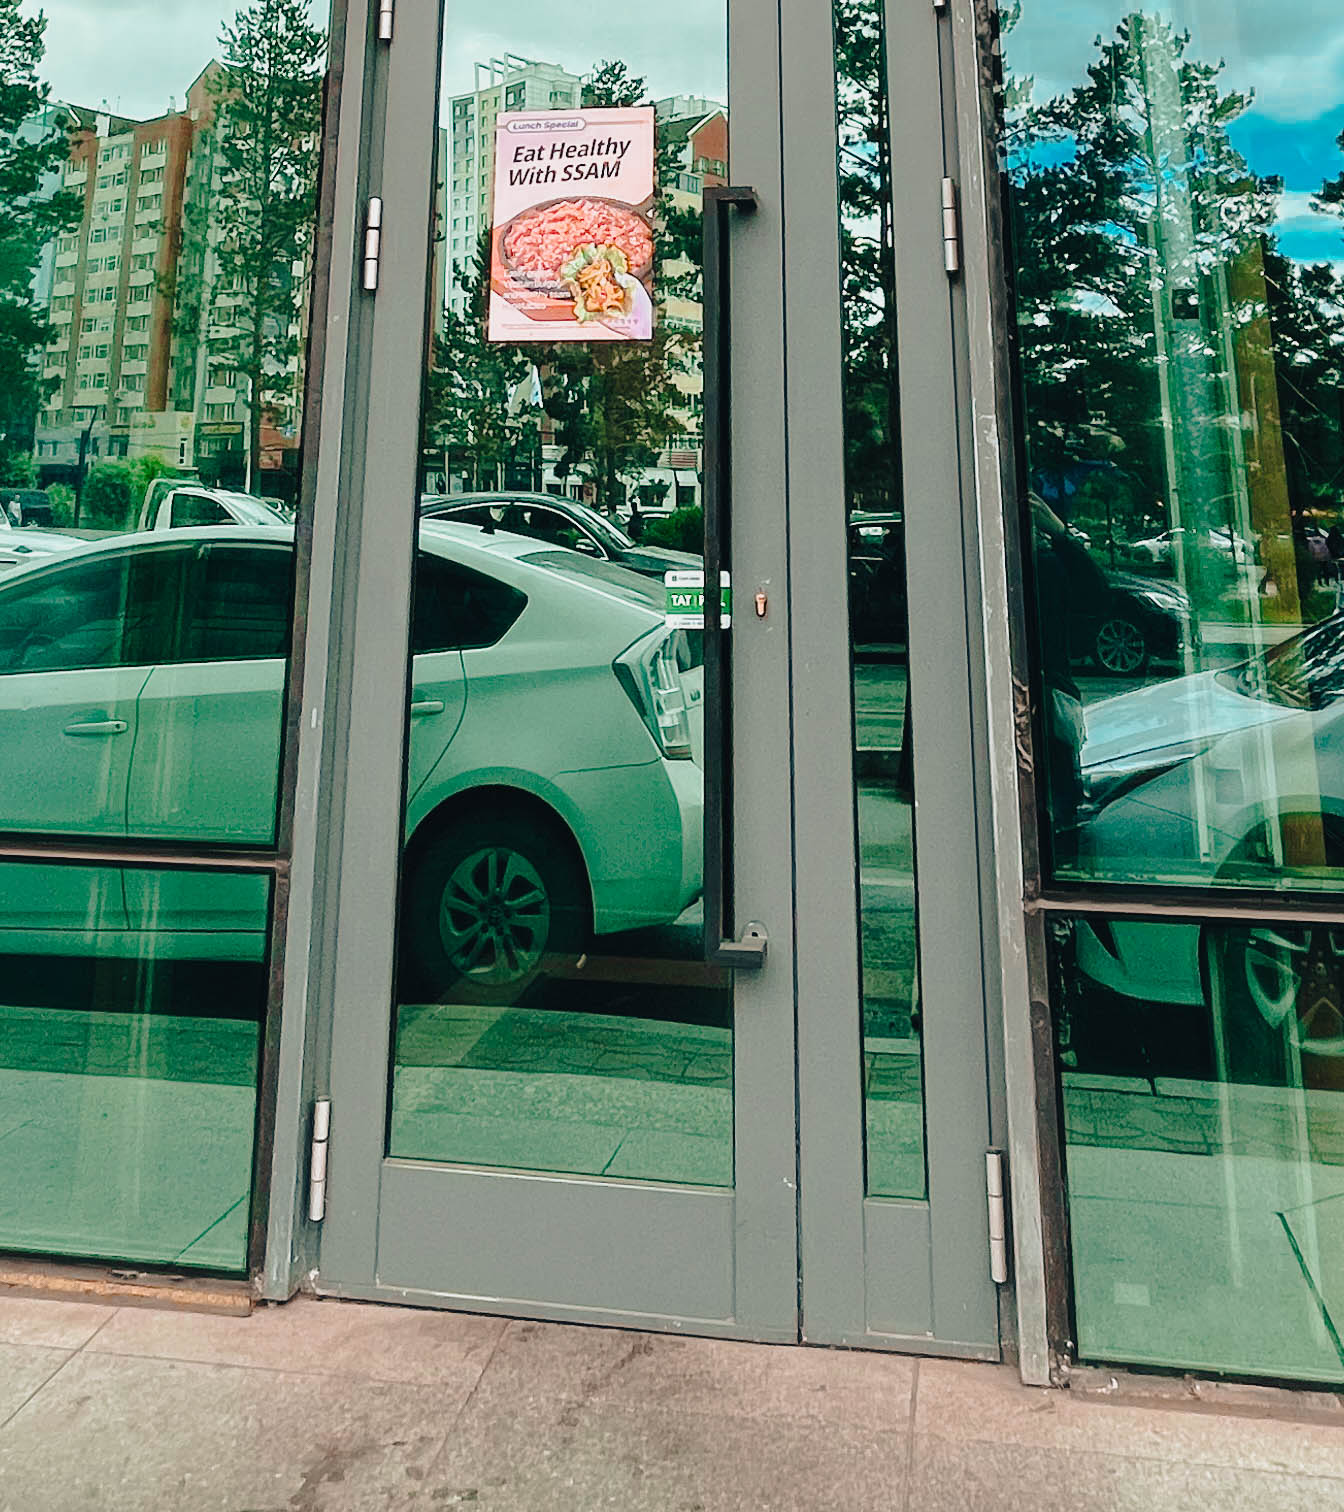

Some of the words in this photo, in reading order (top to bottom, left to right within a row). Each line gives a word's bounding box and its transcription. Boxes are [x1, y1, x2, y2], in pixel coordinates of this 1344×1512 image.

[512, 121, 542, 131] Lunch
[543, 120, 579, 131] Special
[513, 144, 545, 163] Eat
[549, 136, 631, 160] Healthy
[508, 164, 557, 186] With
[561, 161, 621, 182] SSAM
